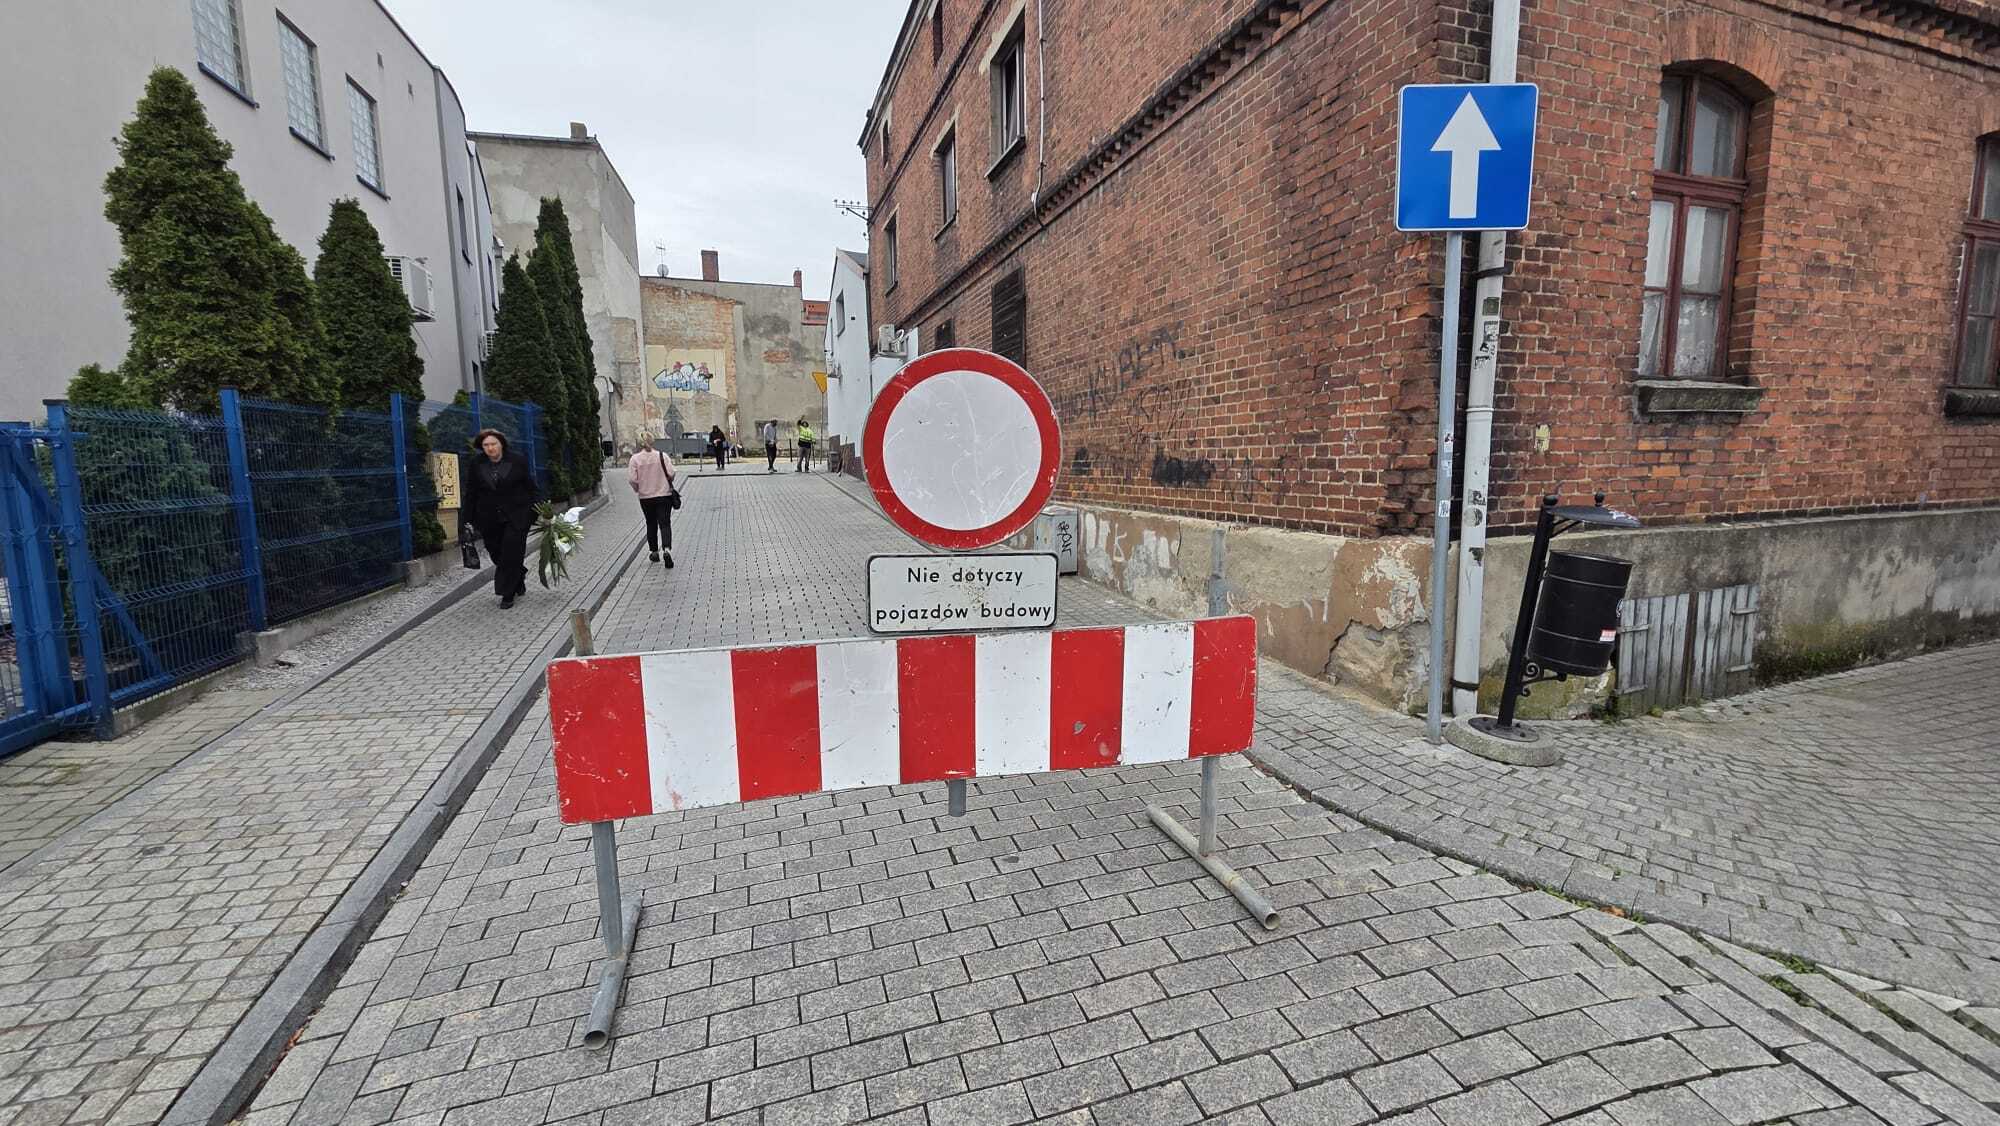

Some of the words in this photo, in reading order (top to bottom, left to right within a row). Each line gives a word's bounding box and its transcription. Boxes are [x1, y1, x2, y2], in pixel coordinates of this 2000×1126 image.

[907, 567, 940, 583] Nie
[952, 567, 1023, 586] dotyczy
[876, 603, 969, 624] pojazdów
[981, 602, 1051, 621] budowy
